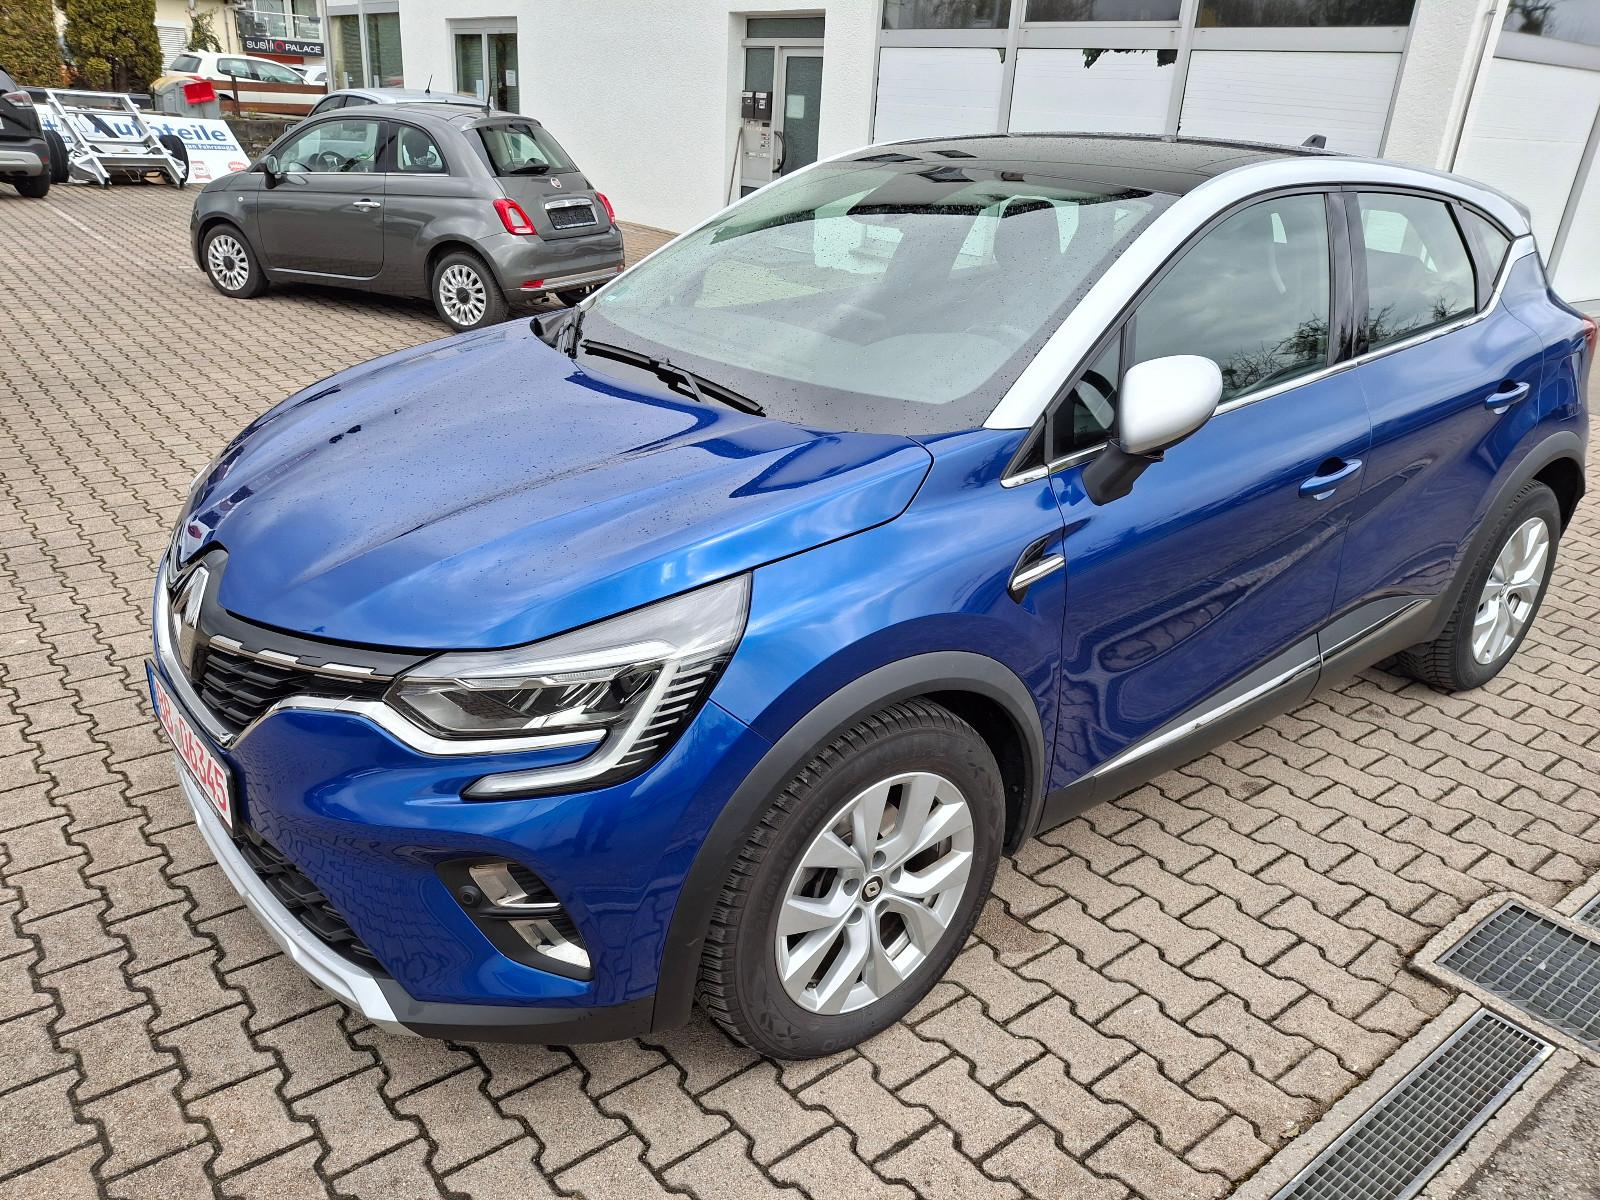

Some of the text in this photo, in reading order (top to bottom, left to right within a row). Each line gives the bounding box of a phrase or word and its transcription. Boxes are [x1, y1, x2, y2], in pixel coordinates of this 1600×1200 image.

[246, 40, 321, 54] SUSHI PALACE
[178, 716, 227, 813] 06345
